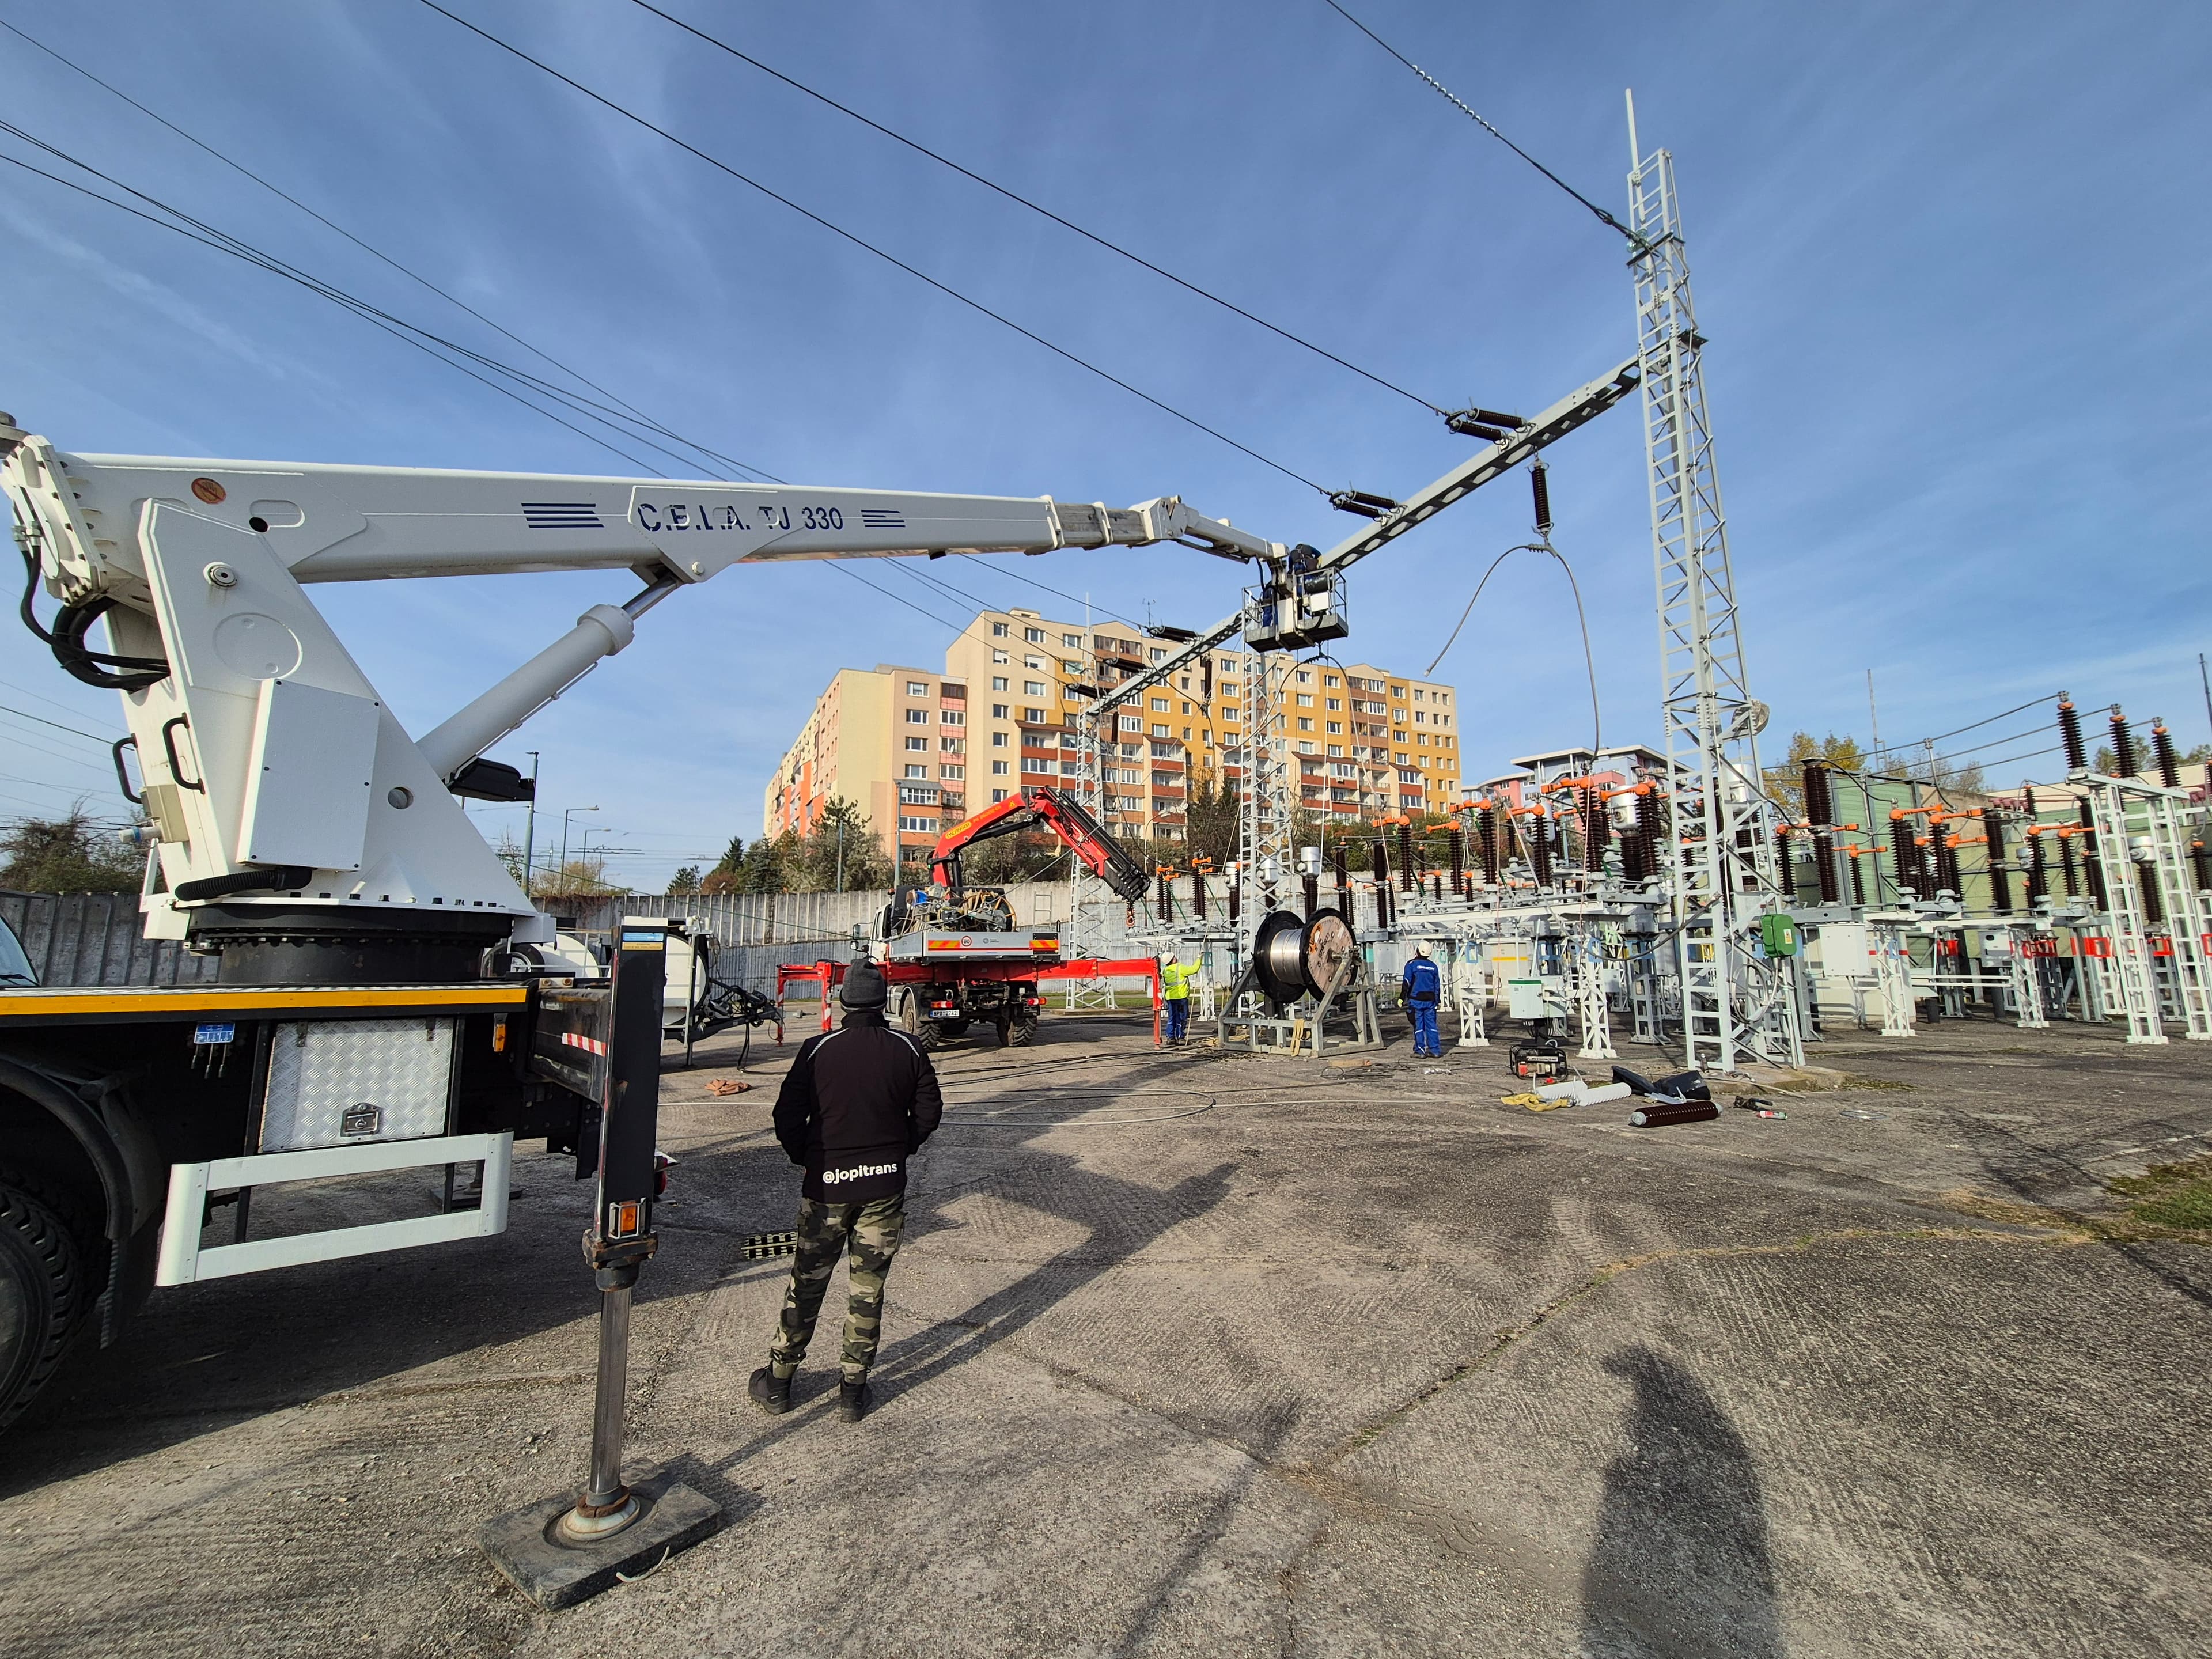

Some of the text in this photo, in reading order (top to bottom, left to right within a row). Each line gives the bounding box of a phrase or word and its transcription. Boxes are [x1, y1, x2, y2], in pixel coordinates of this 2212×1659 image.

[757, 506, 790, 530] TJ
[802, 506, 843, 530] 330
[823, 1163, 897, 1184] @jopitrans
